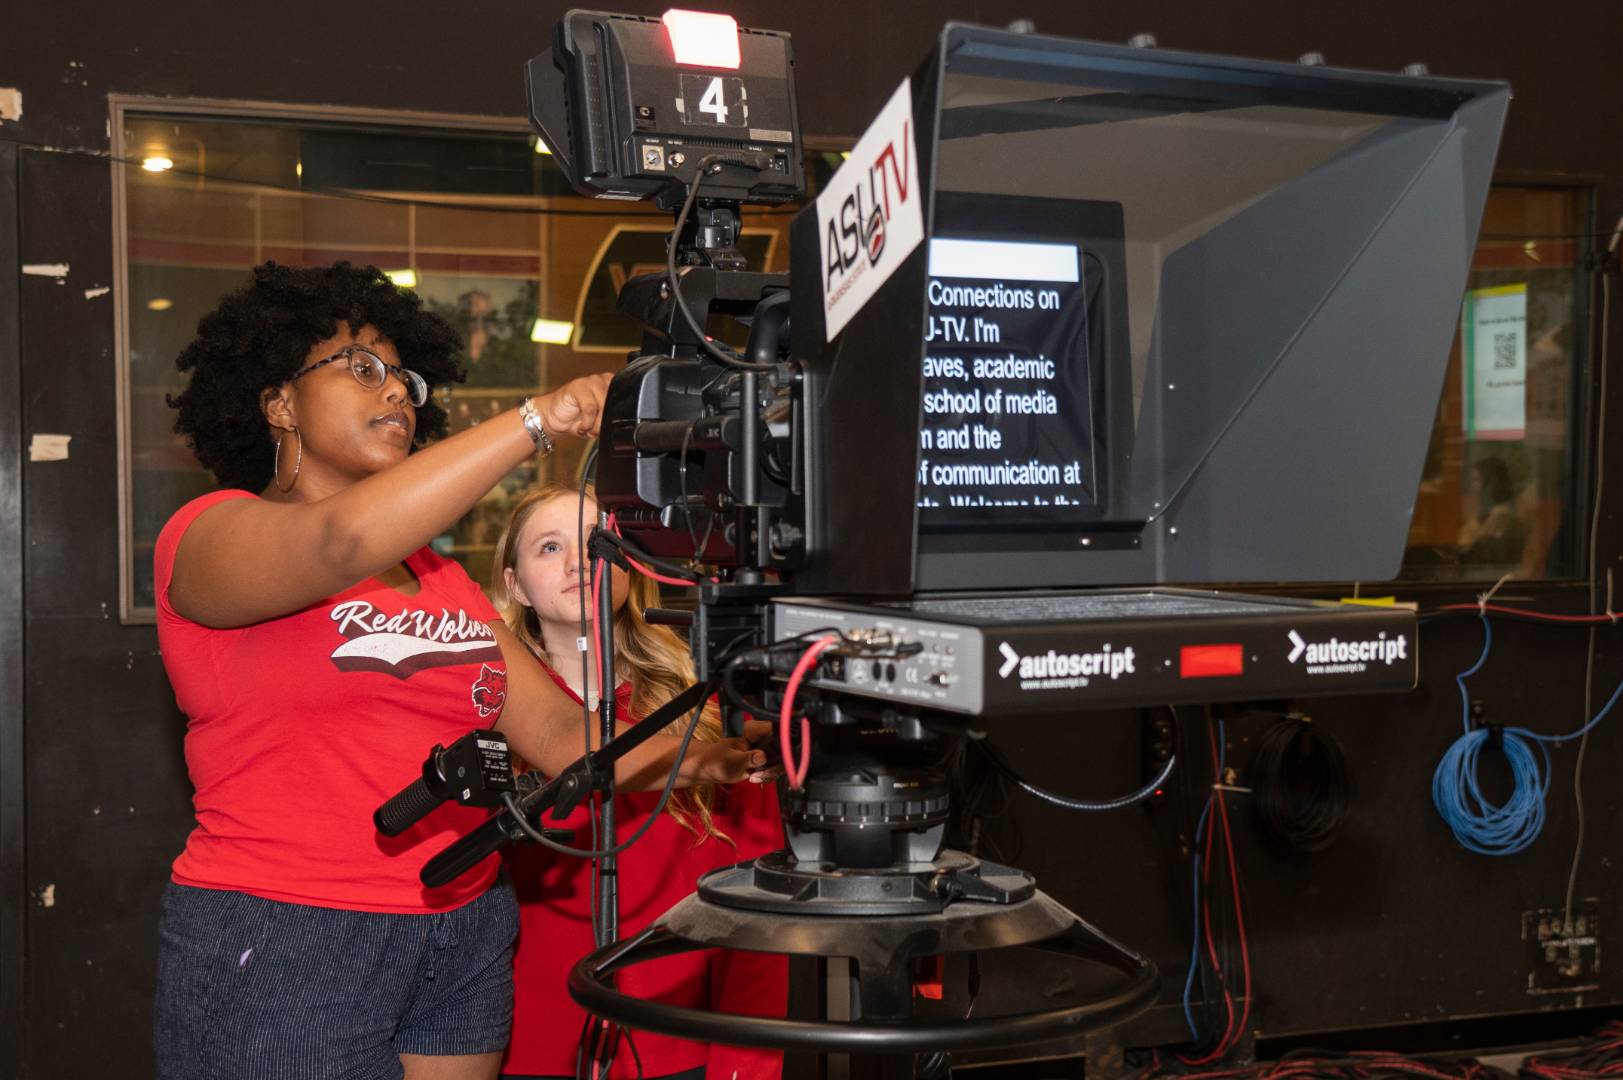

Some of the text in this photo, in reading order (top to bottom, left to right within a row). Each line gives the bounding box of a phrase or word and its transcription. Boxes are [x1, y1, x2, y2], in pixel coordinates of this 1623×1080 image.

[699, 76, 728, 123] 4
[928, 279, 1060, 310] Connections on
[974, 317, 1000, 343] I'm
[973, 353, 1056, 380] academic
[923, 387, 1058, 415] school of media
[936, 423, 970, 450] and
[973, 424, 1002, 450] the
[931, 459, 1060, 486] communication
[1063, 460, 1081, 485] at
[330, 600, 412, 635] Red
[1019, 642, 1136, 680] autoscript
[1305, 631, 1407, 665] autoscript
